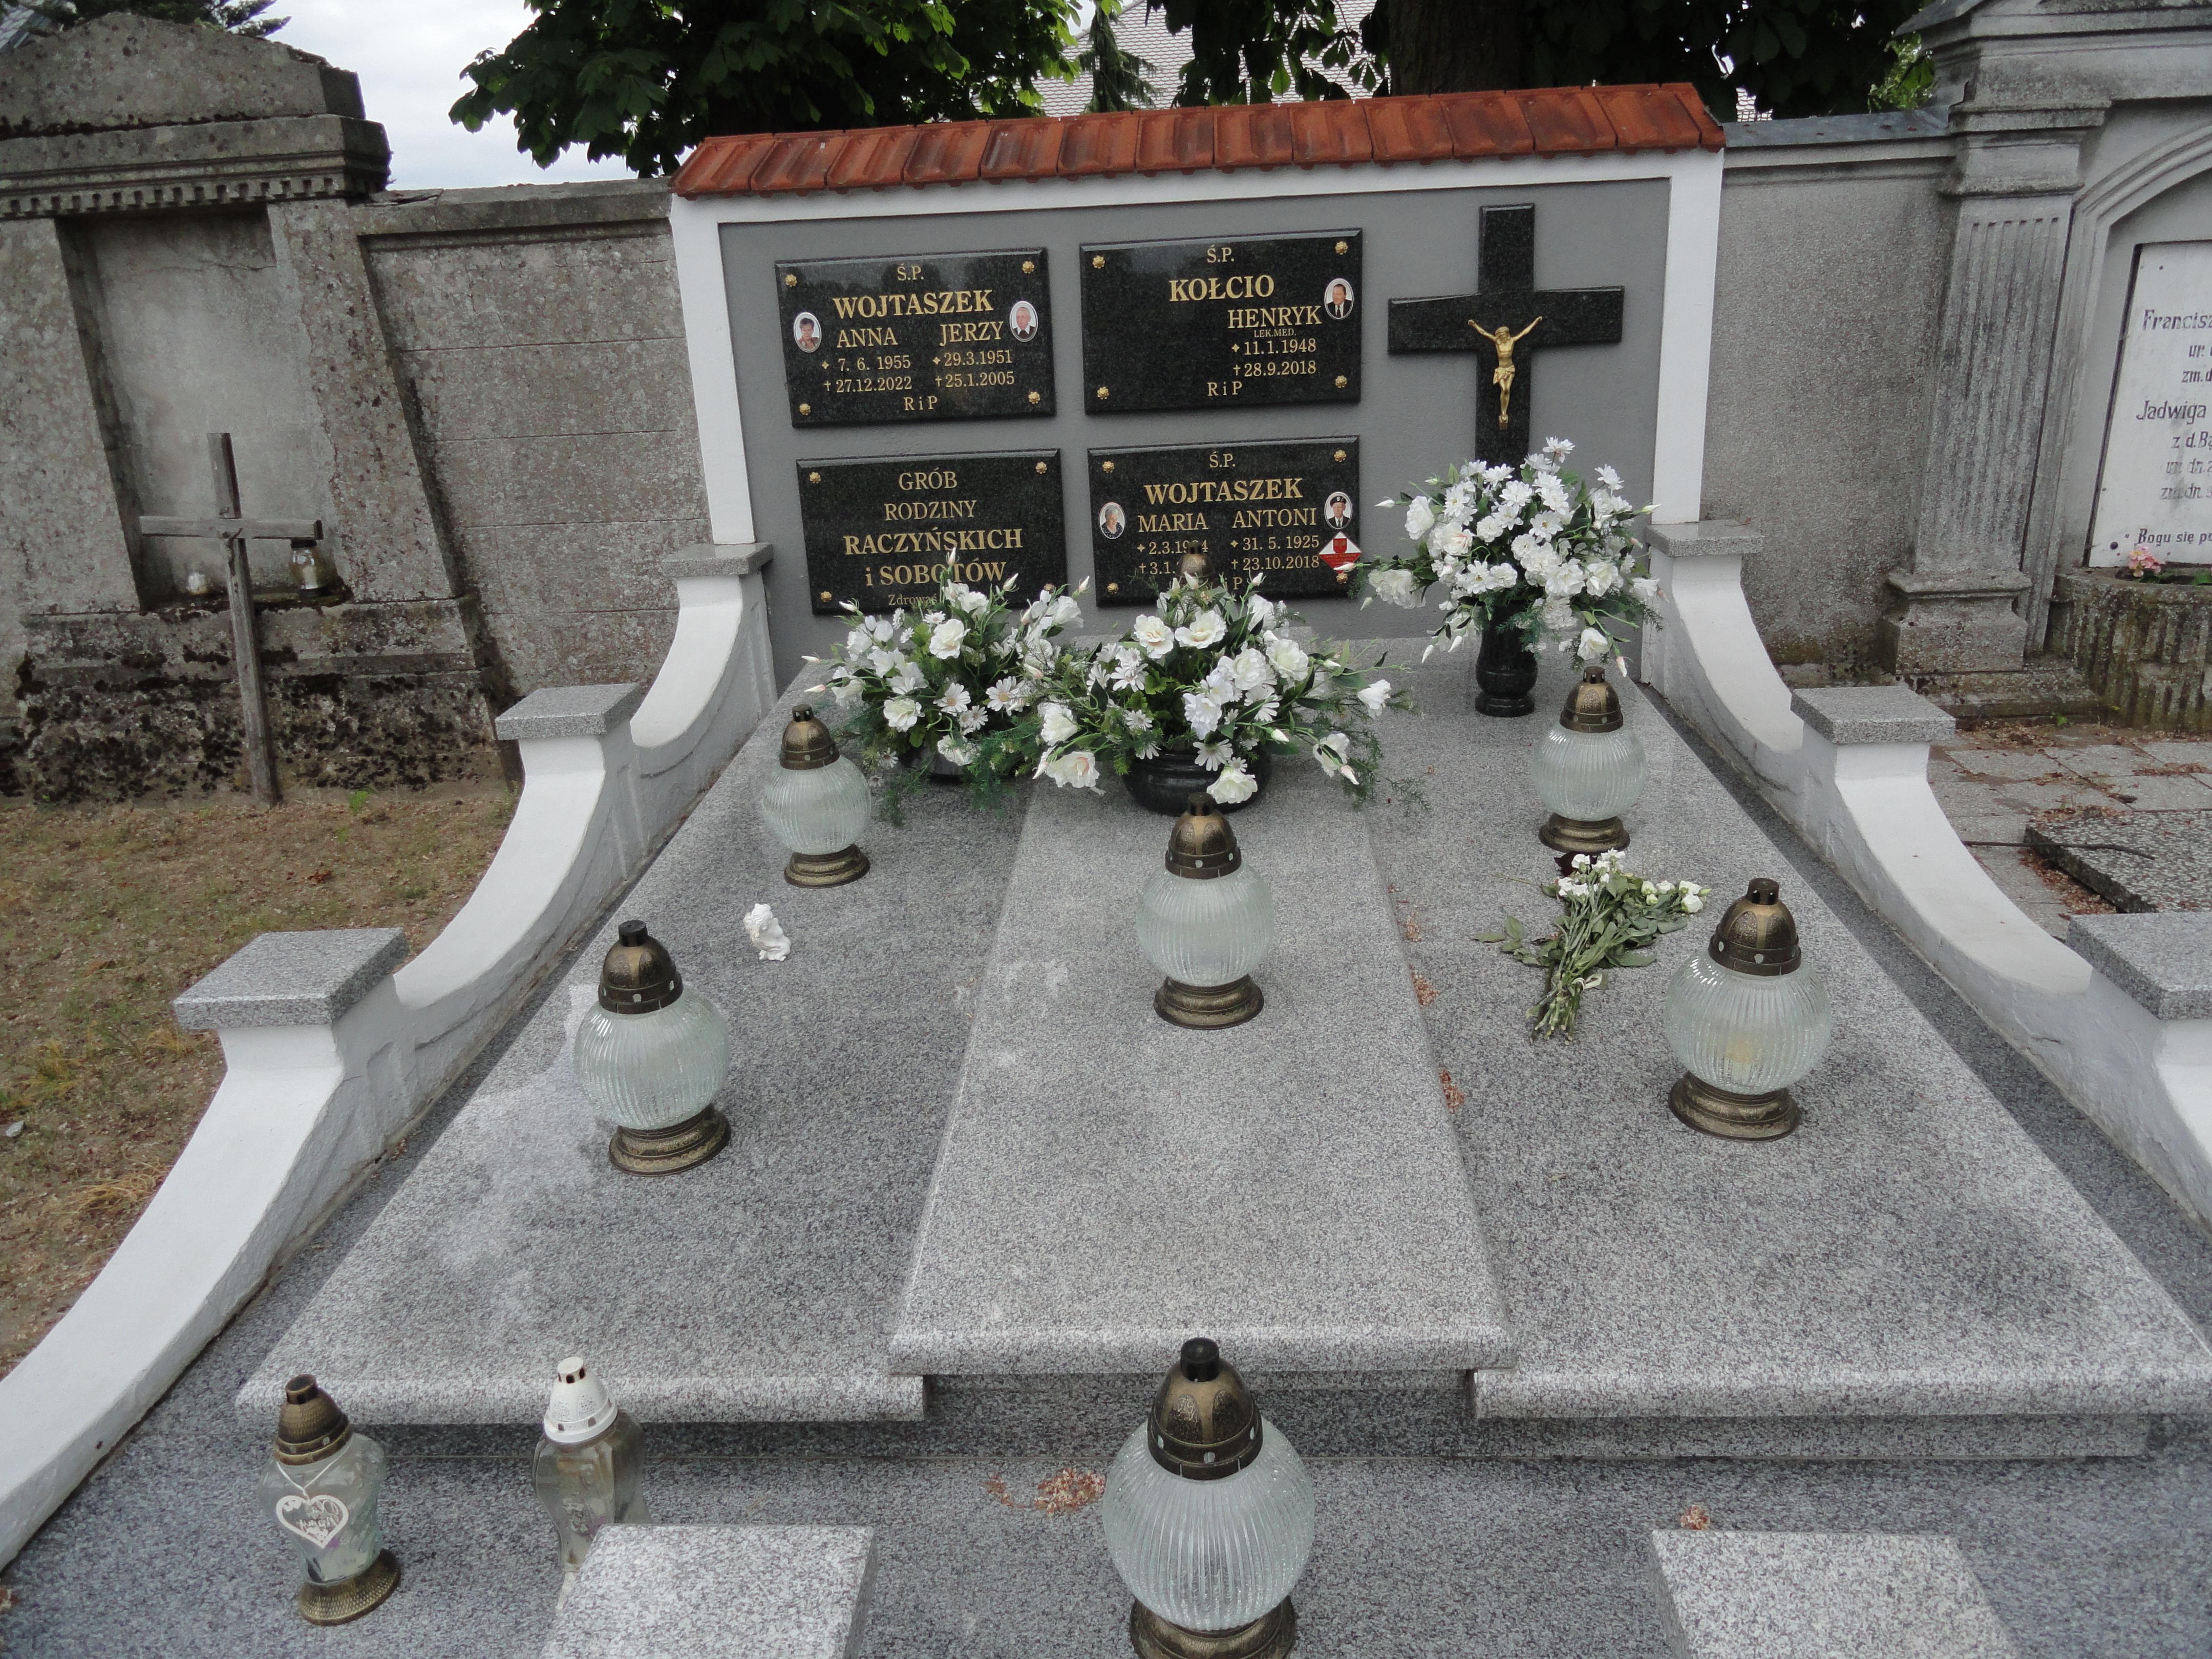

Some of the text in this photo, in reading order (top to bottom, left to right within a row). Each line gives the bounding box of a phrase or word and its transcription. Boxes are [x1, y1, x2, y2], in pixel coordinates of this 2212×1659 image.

[1207, 245, 1235, 263] Ś.P.
[1169, 274, 1274, 302] KOŁCIO
[832, 289, 994, 320] WOJTASZEK
[1228, 306, 1322, 329] HENRYK
[837, 327, 898, 348] ANNA
[939, 321, 1004, 347] JERZY
[1253, 329, 1296, 338] LEK.MED.
[1245, 338, 1316, 355] 11.1.1948
[877, 354, 911, 370] 1955
[943, 350, 1012, 367] 29.3.1951
[1244, 360, 1316, 377] 28.9.2018
[836, 376, 912, 393] 27.12.2022
[945, 371, 1015, 388] 25.1.2005
[2136, 400, 2206, 425] Jadwiga
[1209, 451, 1236, 468] Ś.P.
[899, 467, 958, 491] GRÓB
[1143, 478, 1303, 505] WOJTASZEK
[884, 500, 977, 521] RODZINY
[1232, 507, 1316, 528] ANTONI
[1137, 512, 1209, 533] MARIA
[843, 526, 1023, 555] RACZYŃSKICH
[1286, 535, 1319, 548] 1925
[2176, 531, 2194, 544] się
[1148, 540, 1208, 555] 2.3.194
[865, 558, 1006, 586] i SOBOTÓW
[1243, 555, 1320, 570] 23.10.2018
